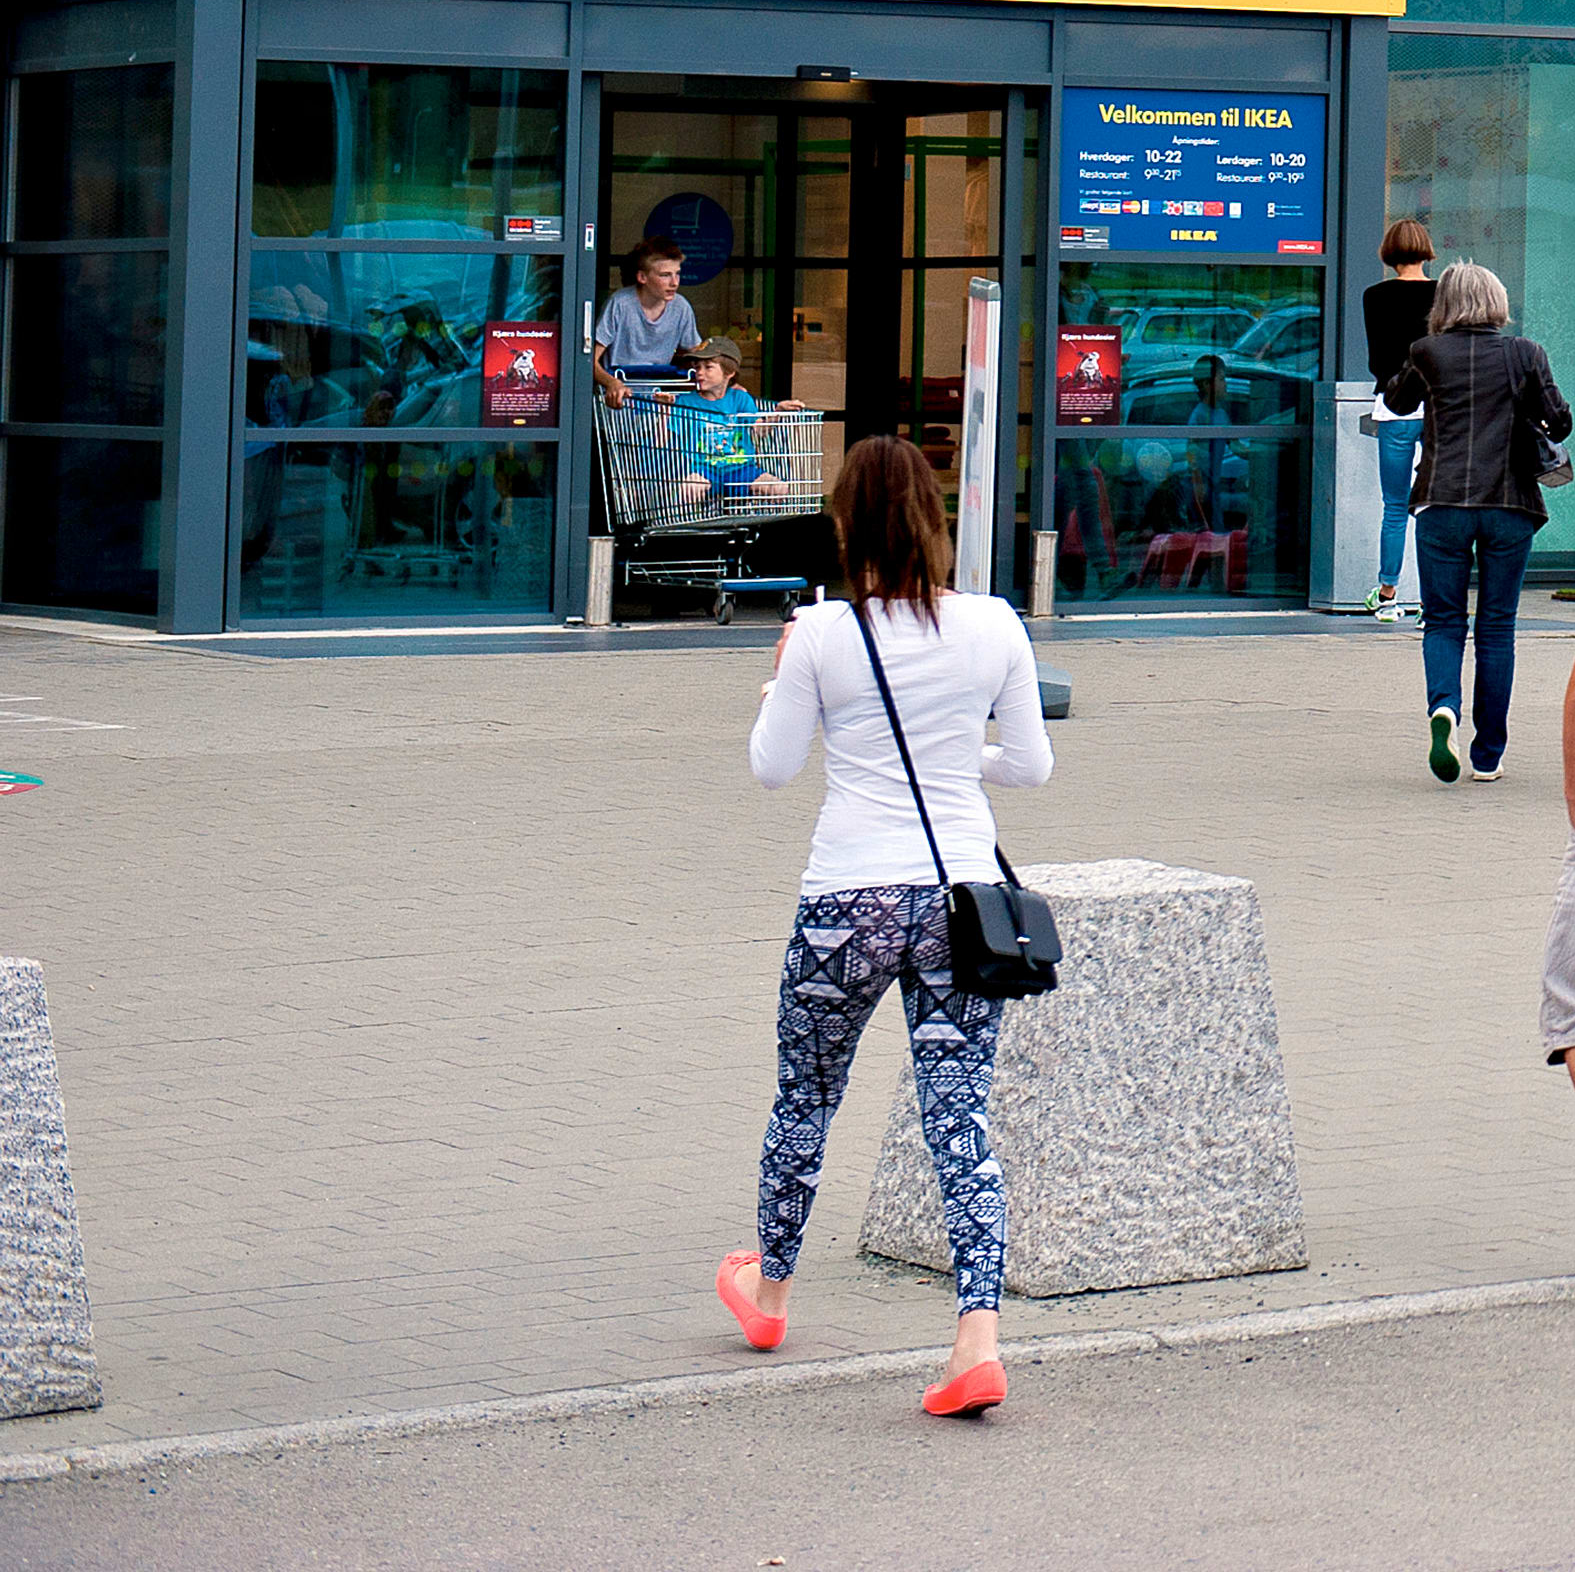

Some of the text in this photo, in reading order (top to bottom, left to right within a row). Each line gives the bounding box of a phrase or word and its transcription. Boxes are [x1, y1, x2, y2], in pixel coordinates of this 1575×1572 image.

[1098, 103, 1293, 129] Velkommen til IKEA
[1079, 149, 1183, 164] Hverdager: 10-22
[1269, 152, 1307, 167] 10-20
[1079, 168, 1130, 180] Restaurant:
[1170, 229, 1218, 242] IKEA
